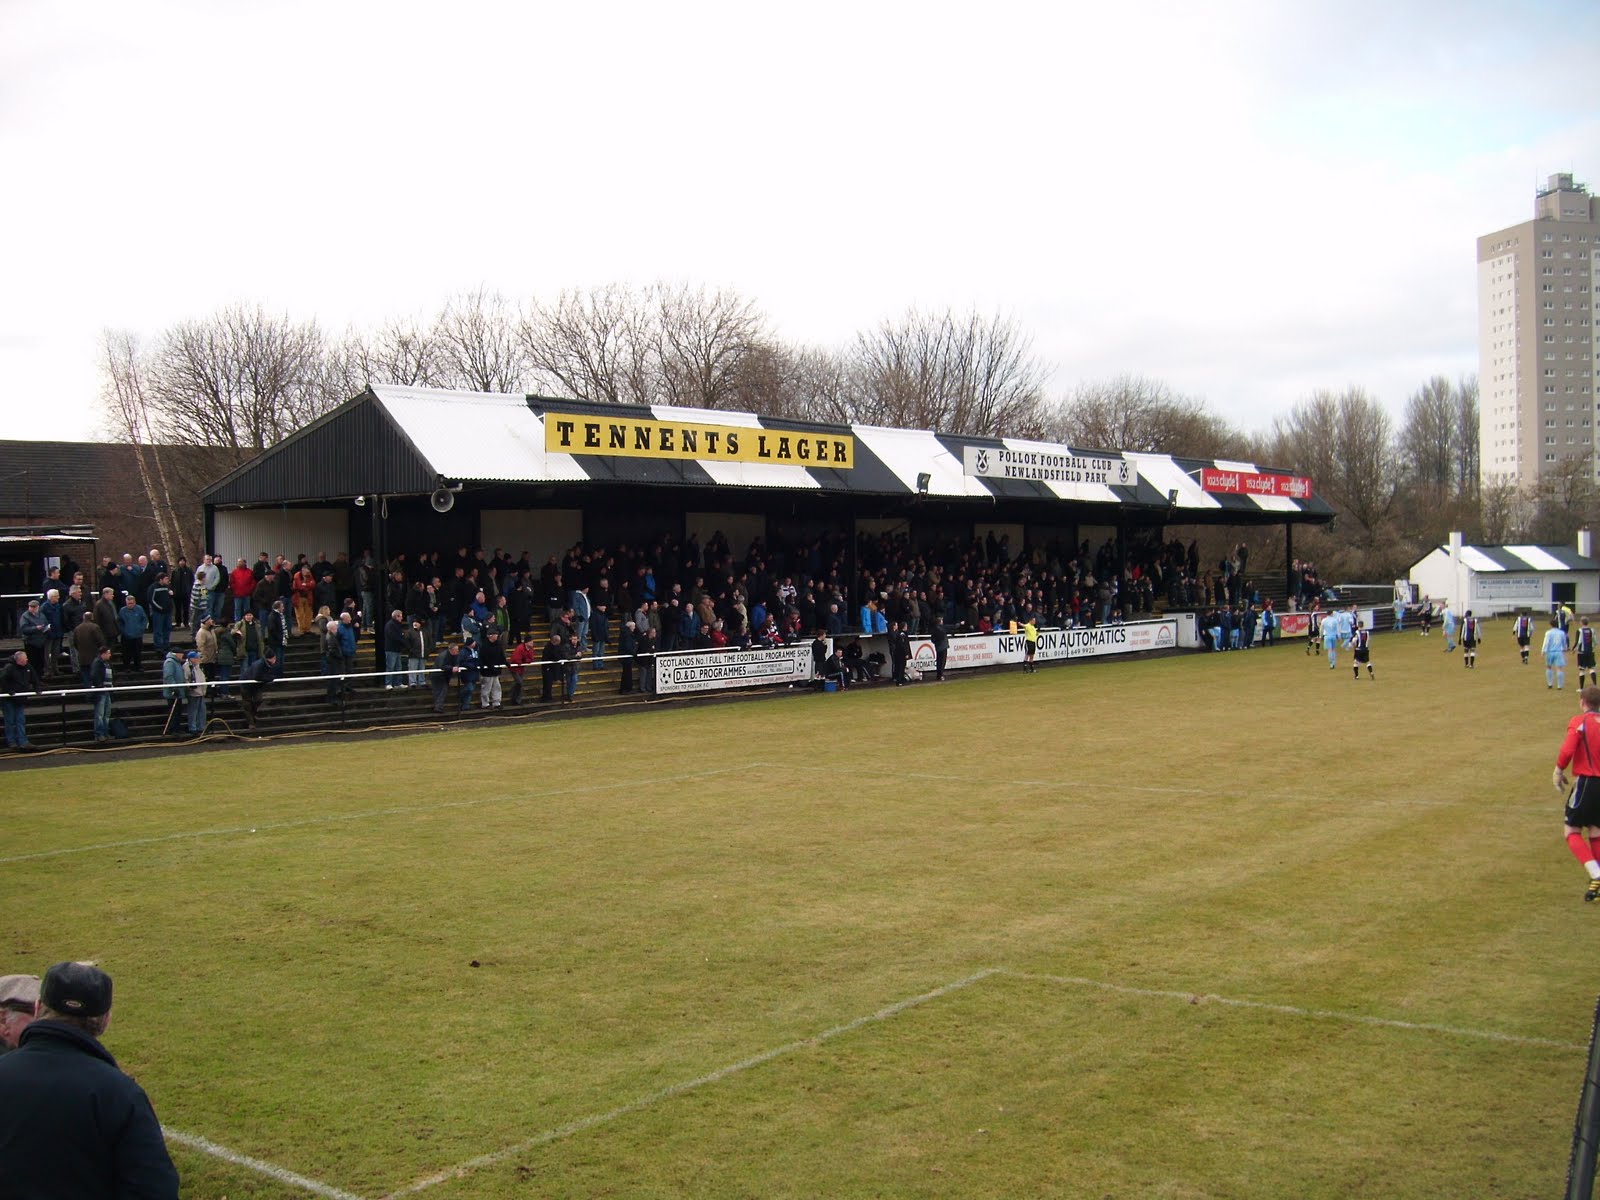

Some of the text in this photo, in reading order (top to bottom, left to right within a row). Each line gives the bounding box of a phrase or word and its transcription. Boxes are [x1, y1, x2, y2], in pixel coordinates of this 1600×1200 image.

[557, 421, 847, 462] TENNENTS LAGER
[999, 451, 1112, 470] POLLOK FOOTBALL CLUB
[1005, 466, 1107, 483] NEWLANDSFIELD PARK
[999, 628, 1126, 653] NEW OIN AUTOMATICS
[660, 658, 694, 668] SCOTLANDS
[709, 656, 722, 664] FULL
[724, 655, 736, 663] TIME
[737, 653, 764, 662] FOOTBALL
[765, 650, 796, 660] PROGRAMME
[797, 649, 810, 658] SHOP
[911, 660, 937, 668] AUTOMATIC
[700, 666, 746, 678] PROGRAMMES
